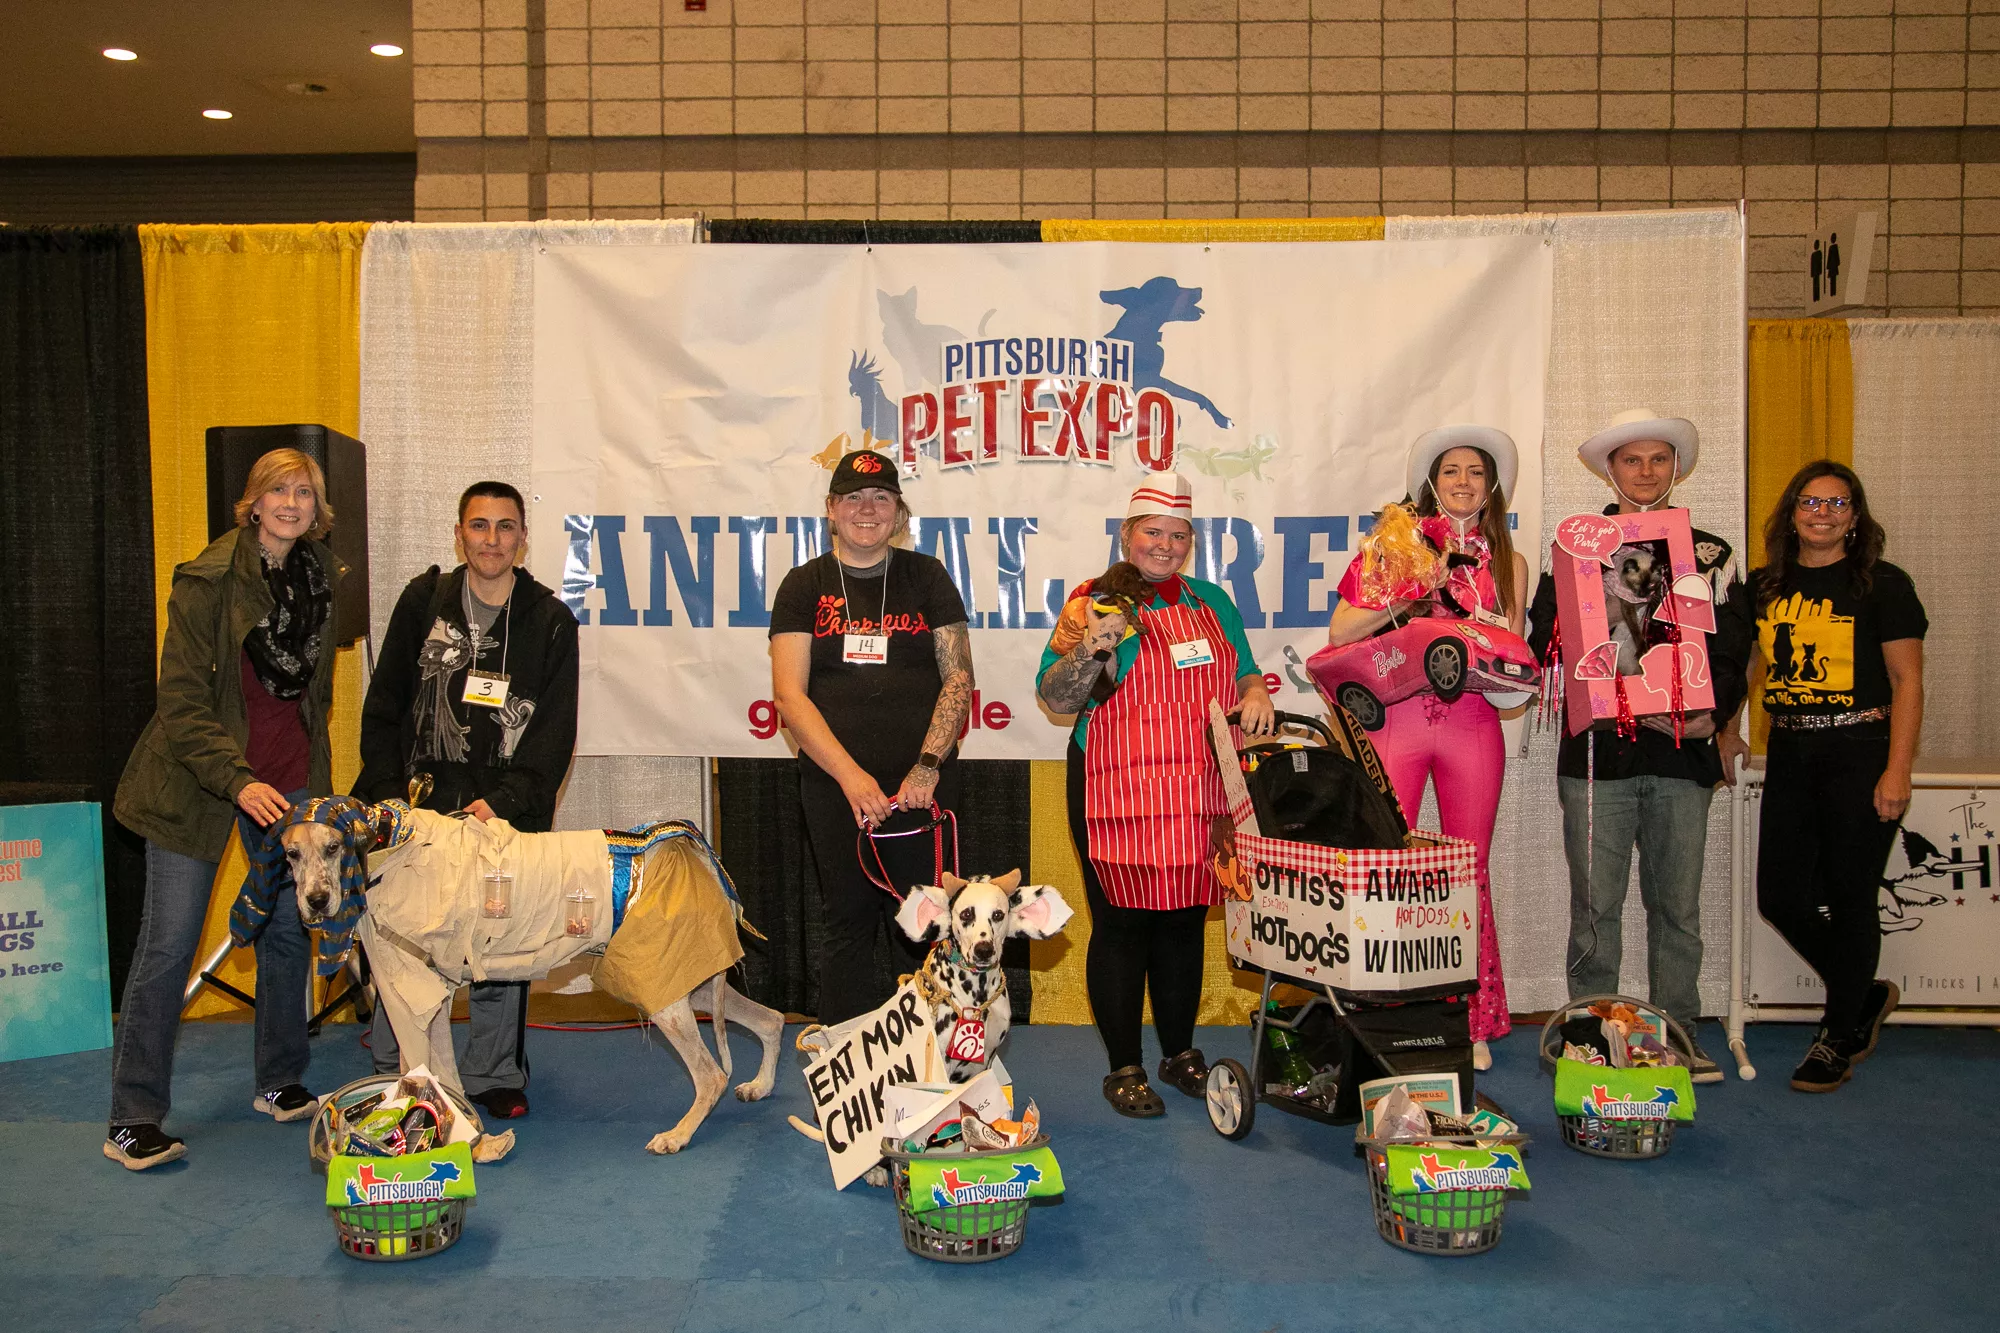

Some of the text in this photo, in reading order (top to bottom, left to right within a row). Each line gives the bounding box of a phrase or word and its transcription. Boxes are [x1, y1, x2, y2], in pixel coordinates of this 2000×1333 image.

[945, 337, 1130, 383] PITTSBURGH
[902, 377, 1177, 474] PET EXPO
[1567, 520, 1597, 534] Let's
[1574, 534, 1601, 552] Party
[560, 514, 1065, 629] ANIAL
[1488, 614, 1500, 624] 5
[858, 638, 875, 652] 14
[1186, 644, 1199, 658] 3
[1372, 646, 1406, 678] Barbie
[478, 682, 494, 696] 3
[1800, 694, 1824, 704] One
[1828, 694, 1854, 707] City
[1346, 714, 1382, 790] HEADER
[1948, 801, 1988, 839] The
[1256, 861, 1345, 912] OTTIS'S
[1365, 867, 1450, 904] AWARD
[1364, 935, 1462, 974] WINNING
[12, 960, 64, 977] here
[808, 990, 924, 1106] EAT MOR
[1604, 1103, 1664, 1116] PITTSBURGH
[1437, 1170, 1506, 1188] PITTSBURGH
[369, 1182, 440, 1200] PITTSBURGH
[956, 1182, 1024, 1204] PITTSBURGH
